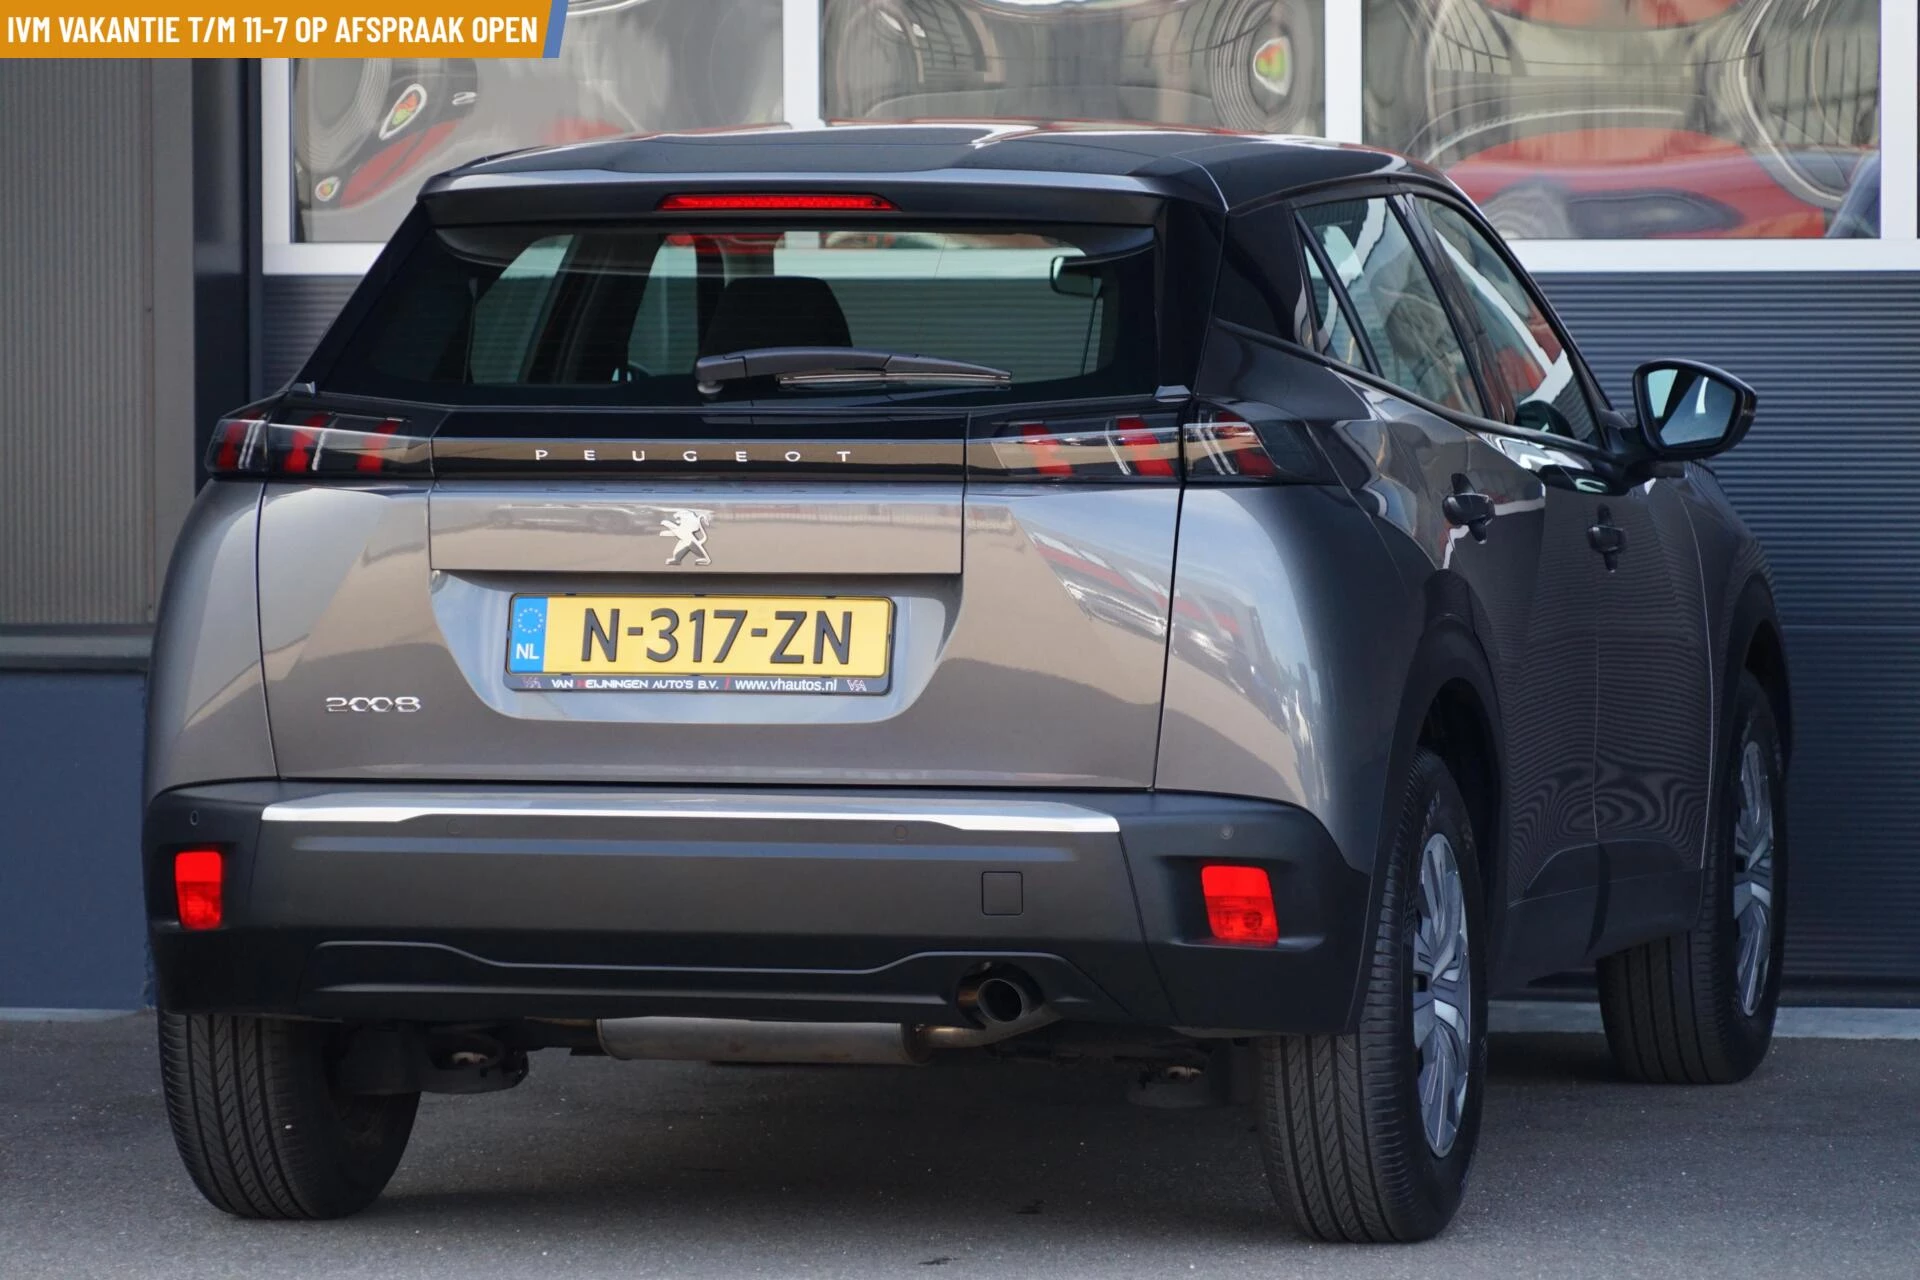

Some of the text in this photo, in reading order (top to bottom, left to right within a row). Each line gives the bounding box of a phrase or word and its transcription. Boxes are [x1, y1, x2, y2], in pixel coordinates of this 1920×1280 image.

[534, 449, 851, 463] PEUGEOT
[580, 607, 852, 665] N-317-ZN
[515, 643, 540, 660] NL
[551, 679, 574, 689] VAN
[652, 679, 694, 690] AUTO'S
[697, 679, 719, 690] B.V.
[735, 677, 838, 693] www.vhautos.nl
[325, 696, 421, 713] 2008
